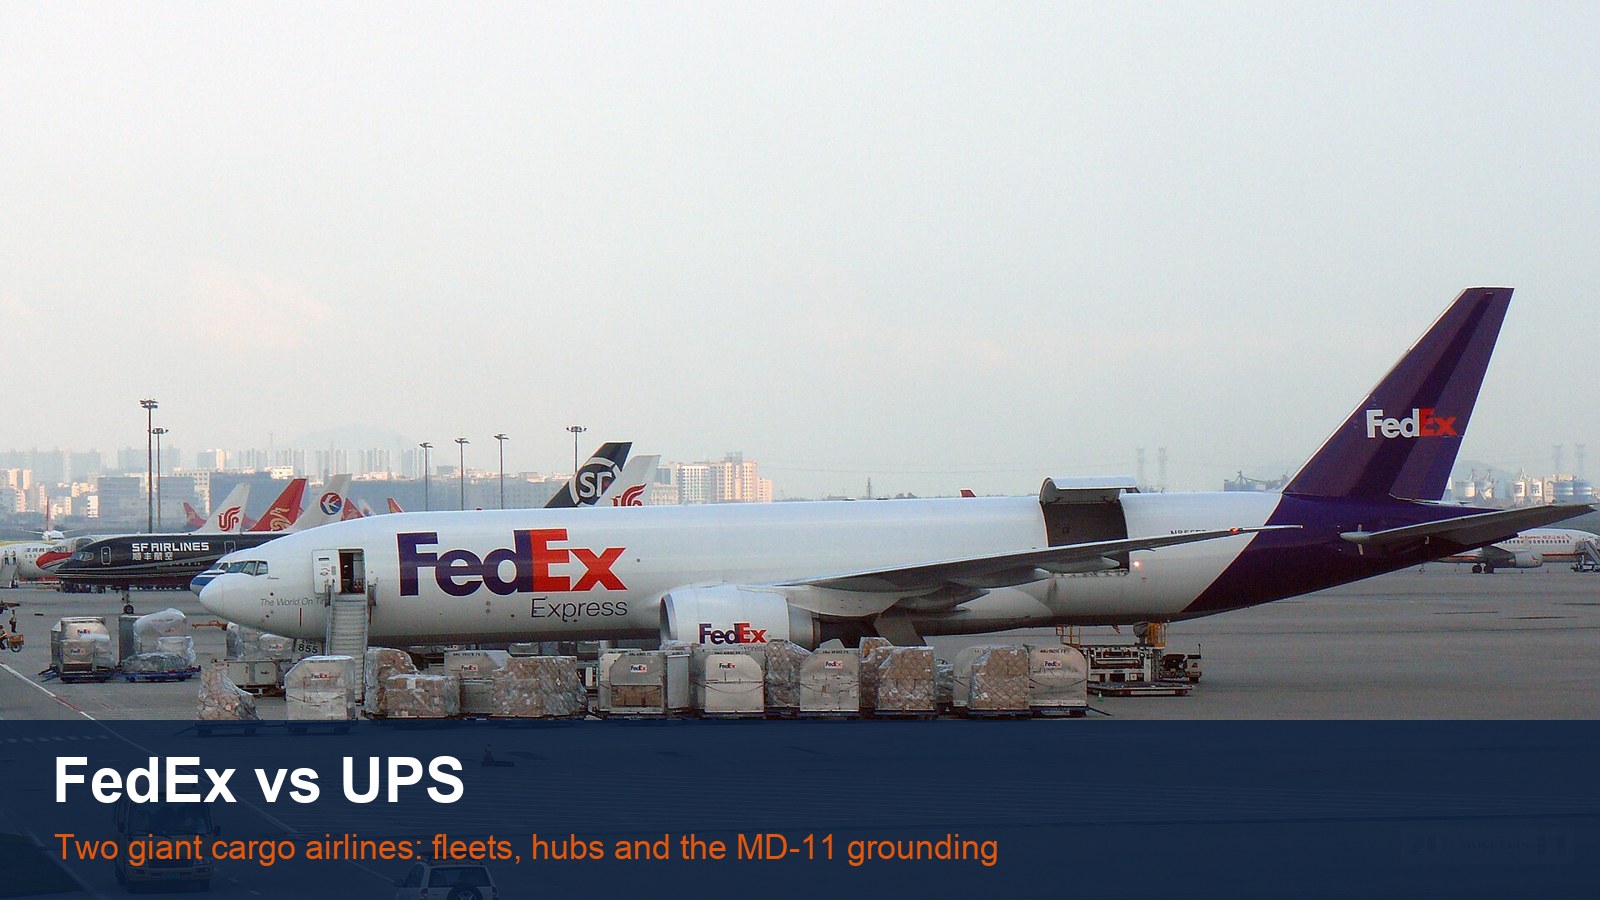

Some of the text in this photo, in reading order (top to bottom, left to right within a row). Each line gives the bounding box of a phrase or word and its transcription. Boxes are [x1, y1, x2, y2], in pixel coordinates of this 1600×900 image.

[1366, 408, 1458, 439] FedEx
[131, 541, 210, 552] SF AIRLINES
[397, 528, 628, 597] FedEx
[260, 598, 274, 606] The
[276, 597, 299, 606] World
[301, 597, 313, 605] On
[530, 597, 629, 622] Express
[699, 623, 767, 645] FedEx
[298, 643, 318, 654] 855
